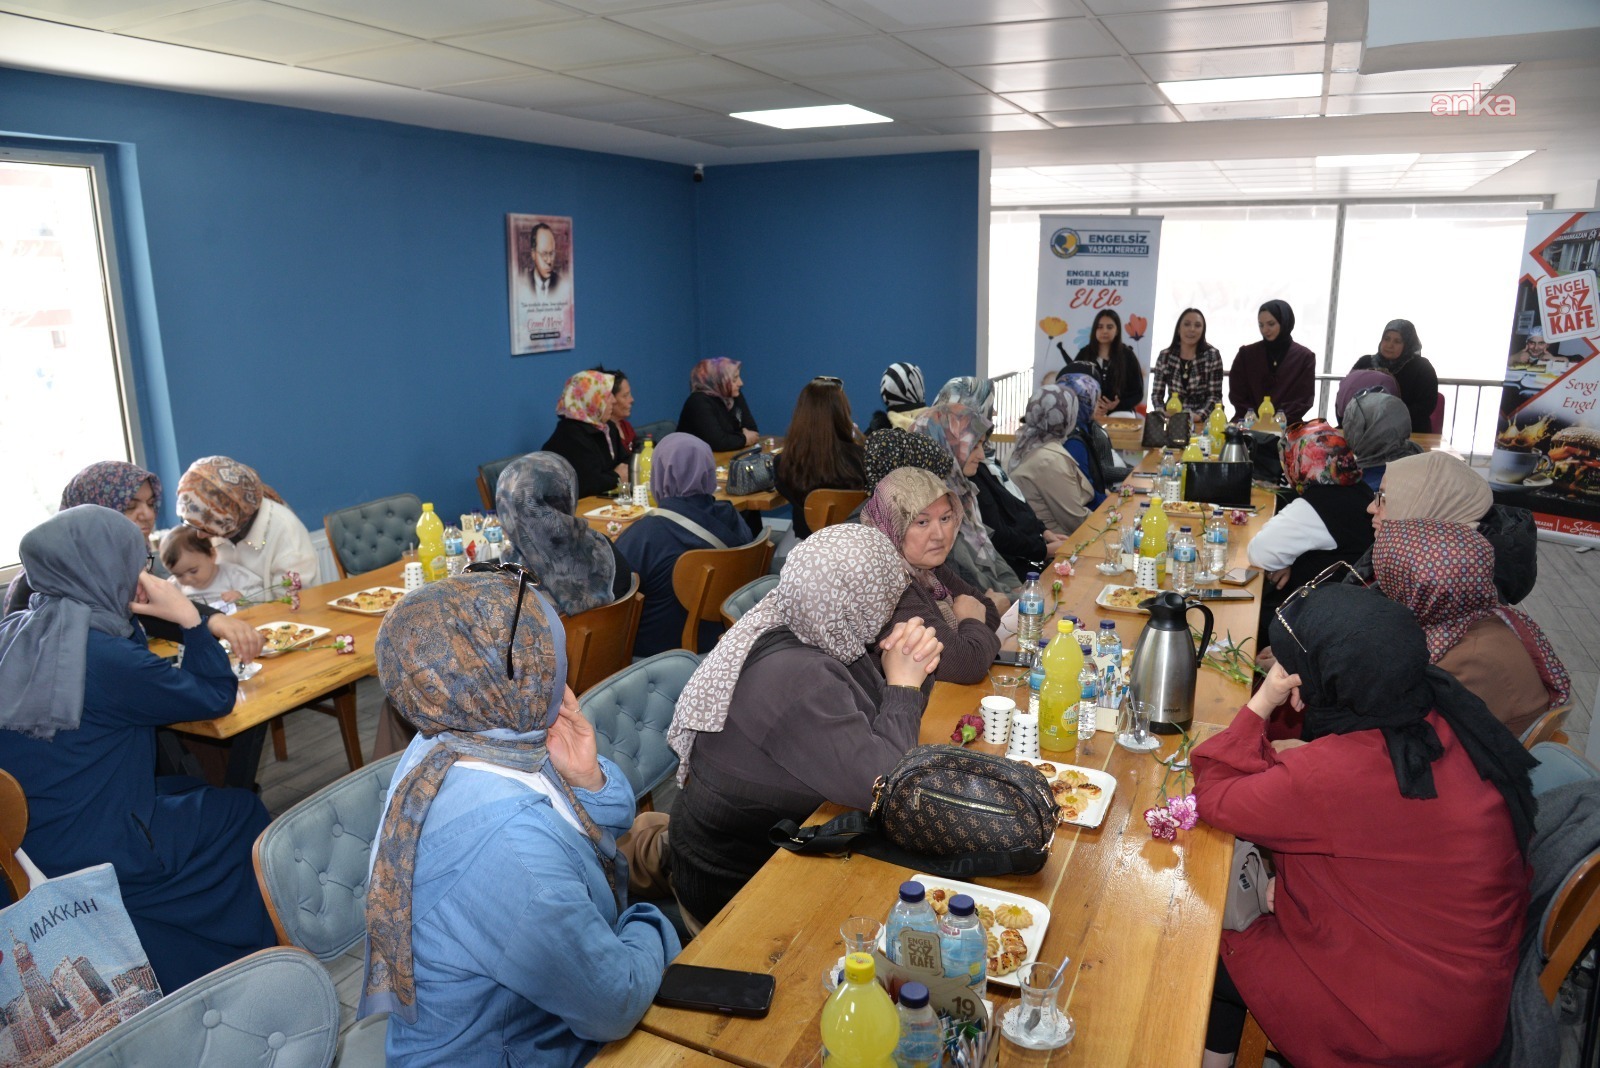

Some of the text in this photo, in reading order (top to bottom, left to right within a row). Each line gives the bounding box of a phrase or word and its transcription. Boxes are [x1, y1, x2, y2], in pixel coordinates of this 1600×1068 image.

[1089, 234, 1147, 244] ENGELSİZ
[1088, 245, 1148, 254] YAŞAM MERKEZİ
[1066, 278, 1128, 286] HEP BİRLİKTE
[1102, 270, 1130, 278] KARŞI
[1545, 278, 1590, 297] ENGEL
[1069, 288, 1123, 309] El Ele
[1549, 309, 1595, 335] KAFE
[1565, 378, 1599, 396] Sevgi
[1562, 397, 1596, 415] Engel
[29, 898, 99, 943] MAKKAH
[908, 937, 931, 946] ENGEL
[909, 953, 935, 969] KAFE
[951, 996, 976, 1017] 19
